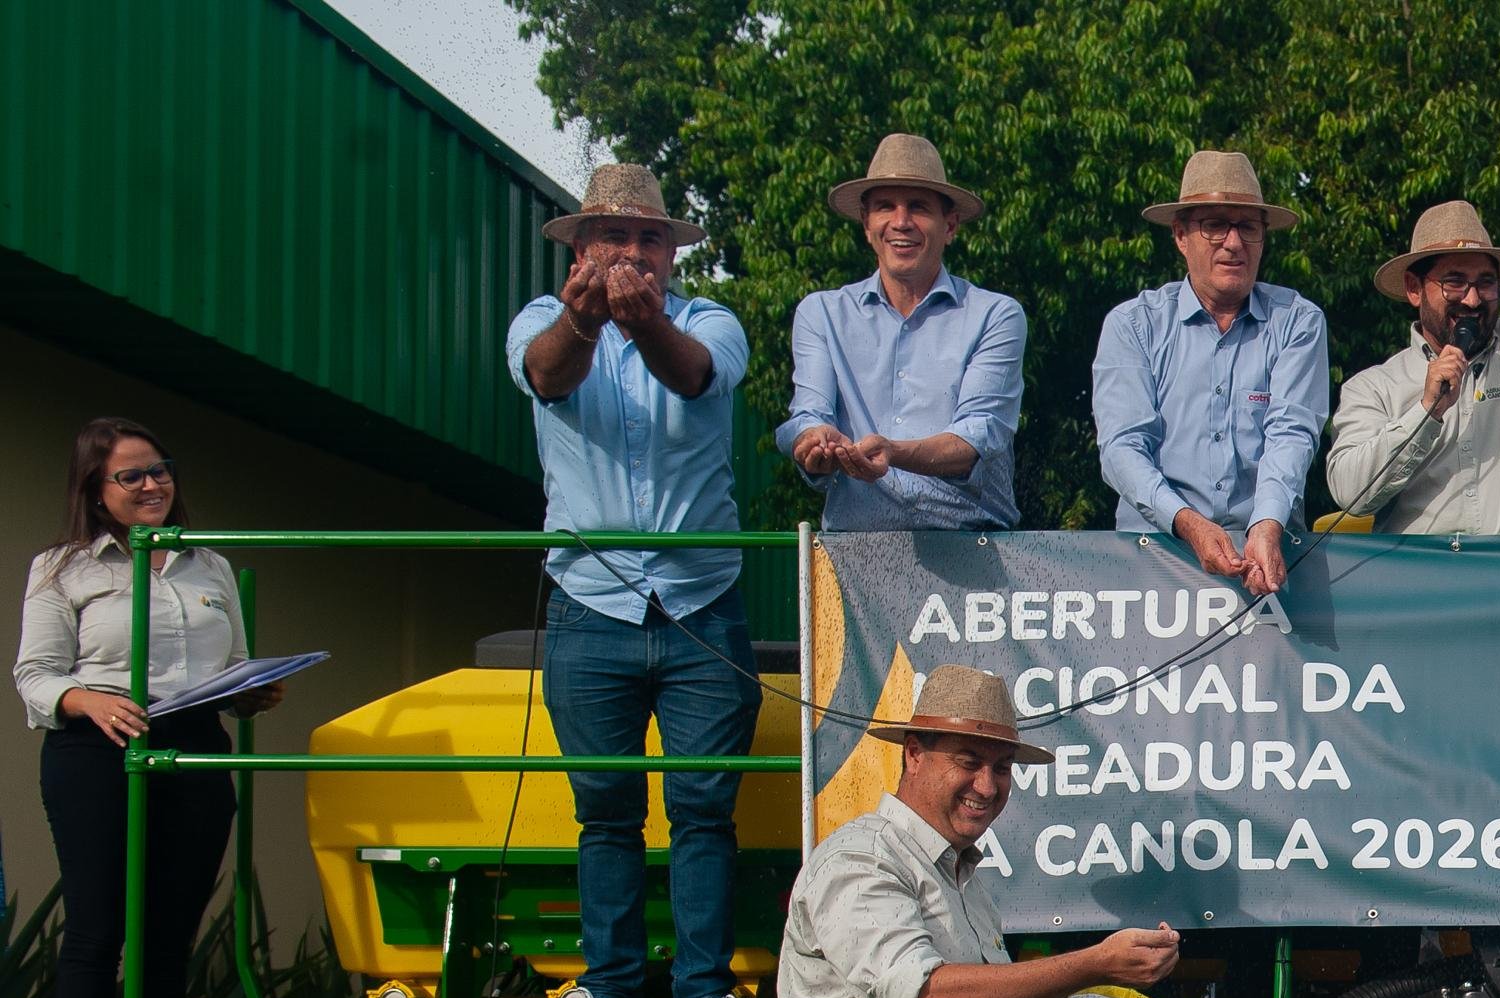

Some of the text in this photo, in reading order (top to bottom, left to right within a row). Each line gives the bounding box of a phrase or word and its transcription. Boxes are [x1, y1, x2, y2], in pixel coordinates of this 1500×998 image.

[910, 588, 1293, 643] ABERTURA
[912, 663, 1405, 717] CIONAL DA
[1008, 741, 1351, 797] MEADURA
[973, 827, 1013, 878] A
[1035, 819, 1328, 877] CANOLA
